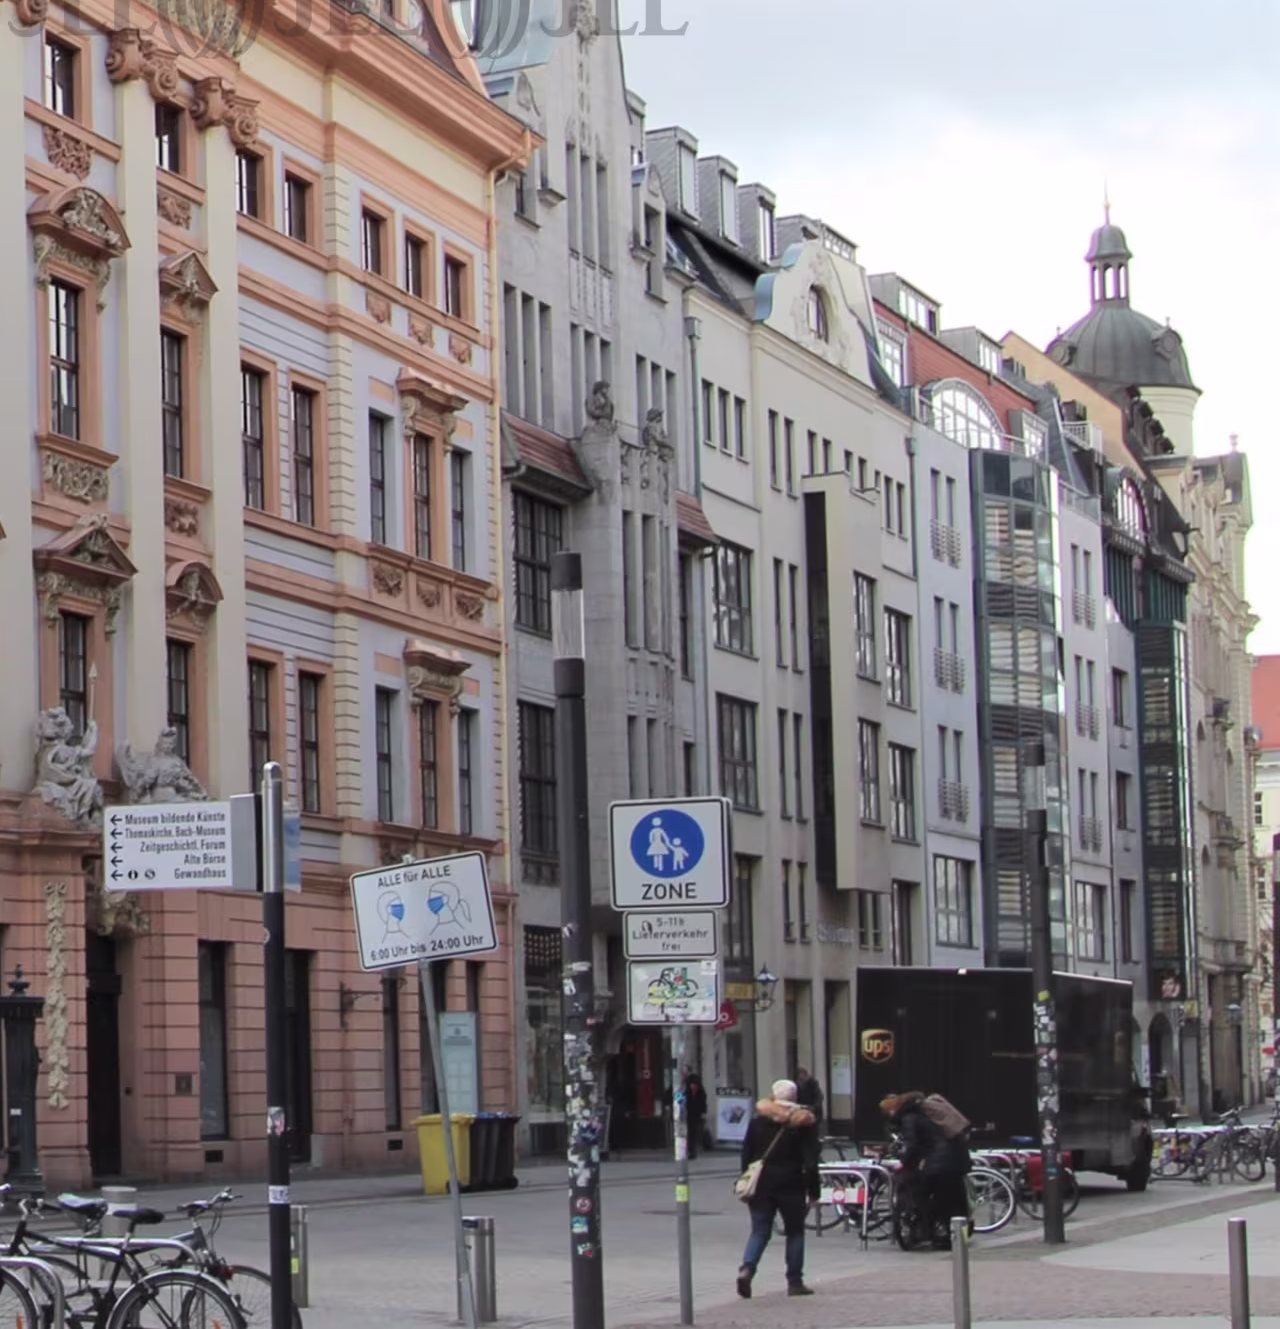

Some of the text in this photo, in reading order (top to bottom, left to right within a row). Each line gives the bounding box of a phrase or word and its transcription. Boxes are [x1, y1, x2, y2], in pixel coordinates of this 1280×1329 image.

[125, 811, 225, 825] Museum bildende Künste
[175, 825, 226, 837] Bach-Museum
[201, 840, 226, 850] Forum
[184, 853, 226, 865] Alte Börse
[174, 867, 226, 880] Gewandhaus
[377, 865, 451, 888] ALLE für ALLE
[641, 882, 697, 900] ZONE
[391, 945, 408, 957] Uhr
[410, 942, 426, 953] bis
[431, 937, 461, 951] 24:00
[463, 935, 484, 947] Uhr
[662, 942, 681, 951] frei
[864, 1039, 890, 1058] ups
